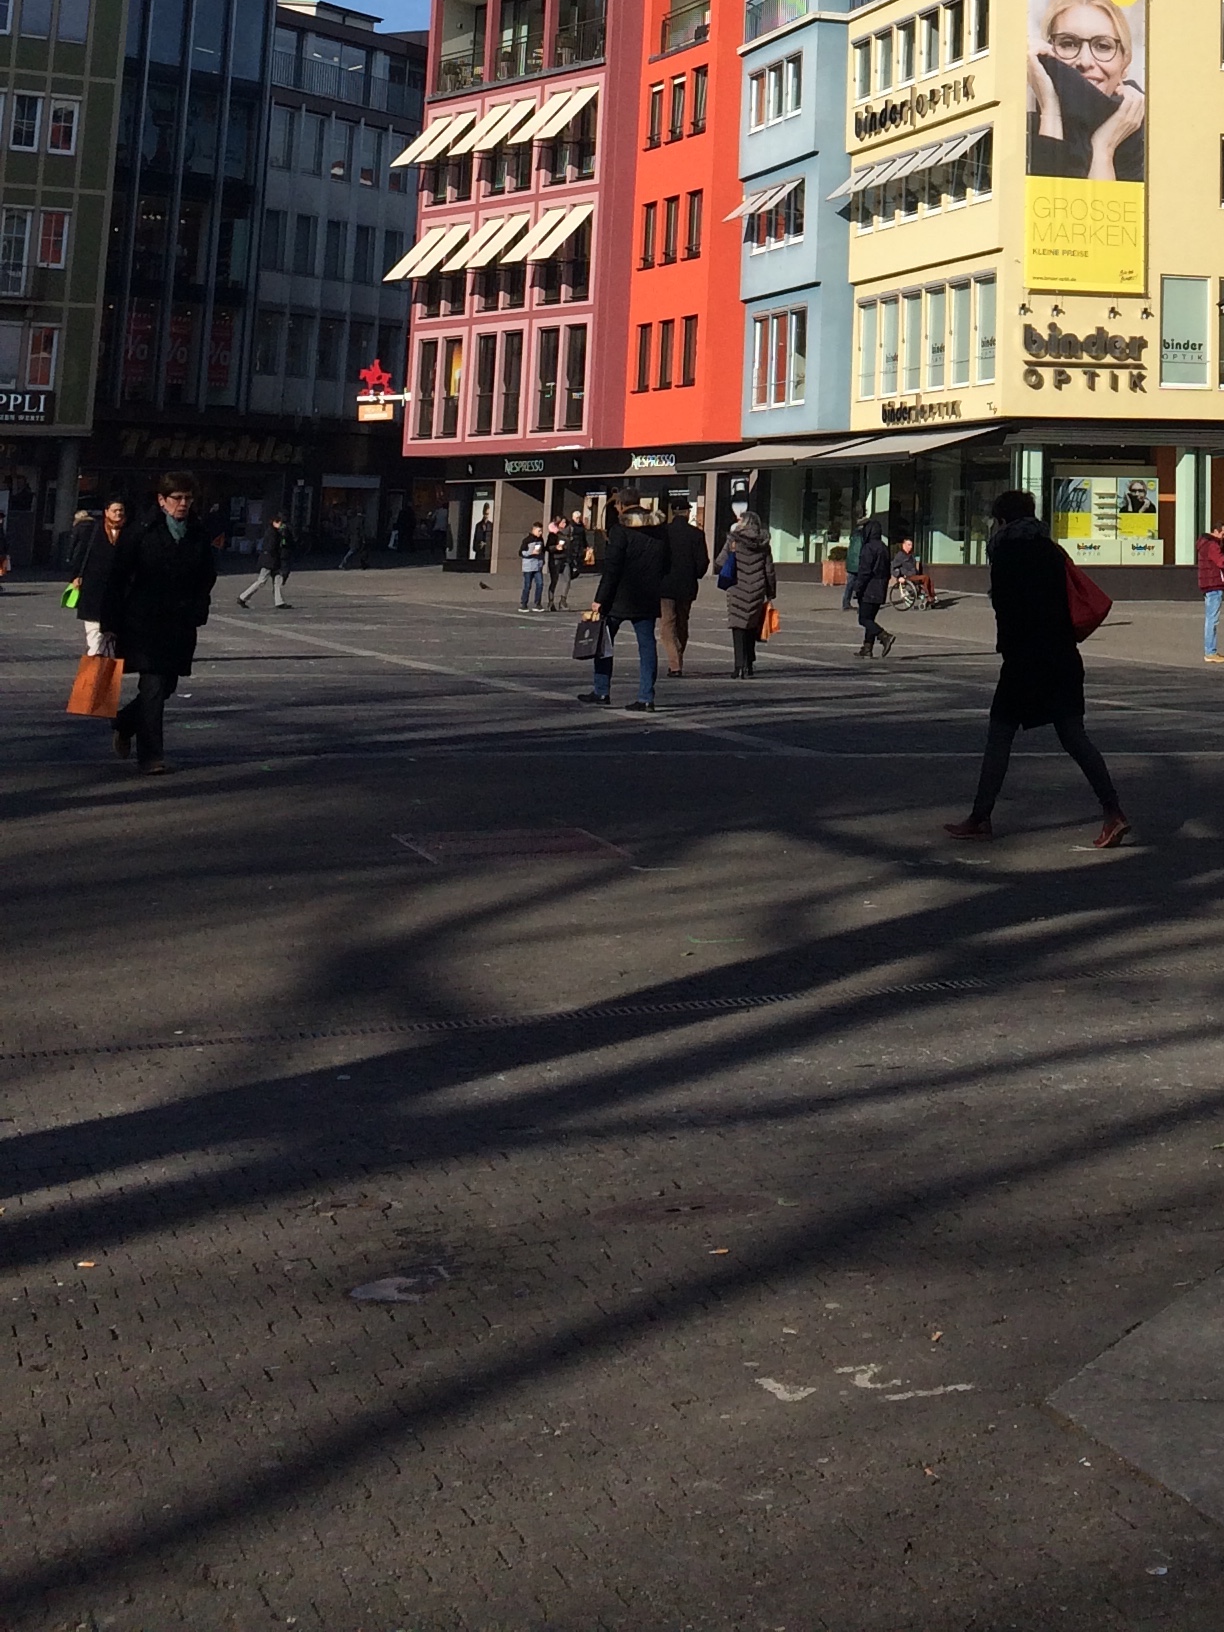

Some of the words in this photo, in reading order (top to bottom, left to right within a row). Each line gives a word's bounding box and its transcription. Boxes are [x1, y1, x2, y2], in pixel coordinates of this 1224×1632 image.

[855, 99, 911, 141] binder
[916, 75, 975, 118] OPTIK
[1033, 196, 1137, 223] GROSSE
[1033, 222, 1137, 248] MARKEN
[1032, 248, 1060, 257] KLEINE
[1061, 249, 1089, 258] PREISE
[1023, 322, 1148, 361] binder
[1163, 339, 1204, 350] binder
[1162, 353, 1203, 361] OPTIK
[1023, 367, 1147, 393] OPTIK
[504, 458, 545, 476] NESPRESSO
[630, 452, 676, 470] NESPRESSO
[1077, 542, 1101, 551] binder
[1131, 542, 1156, 551] binder
